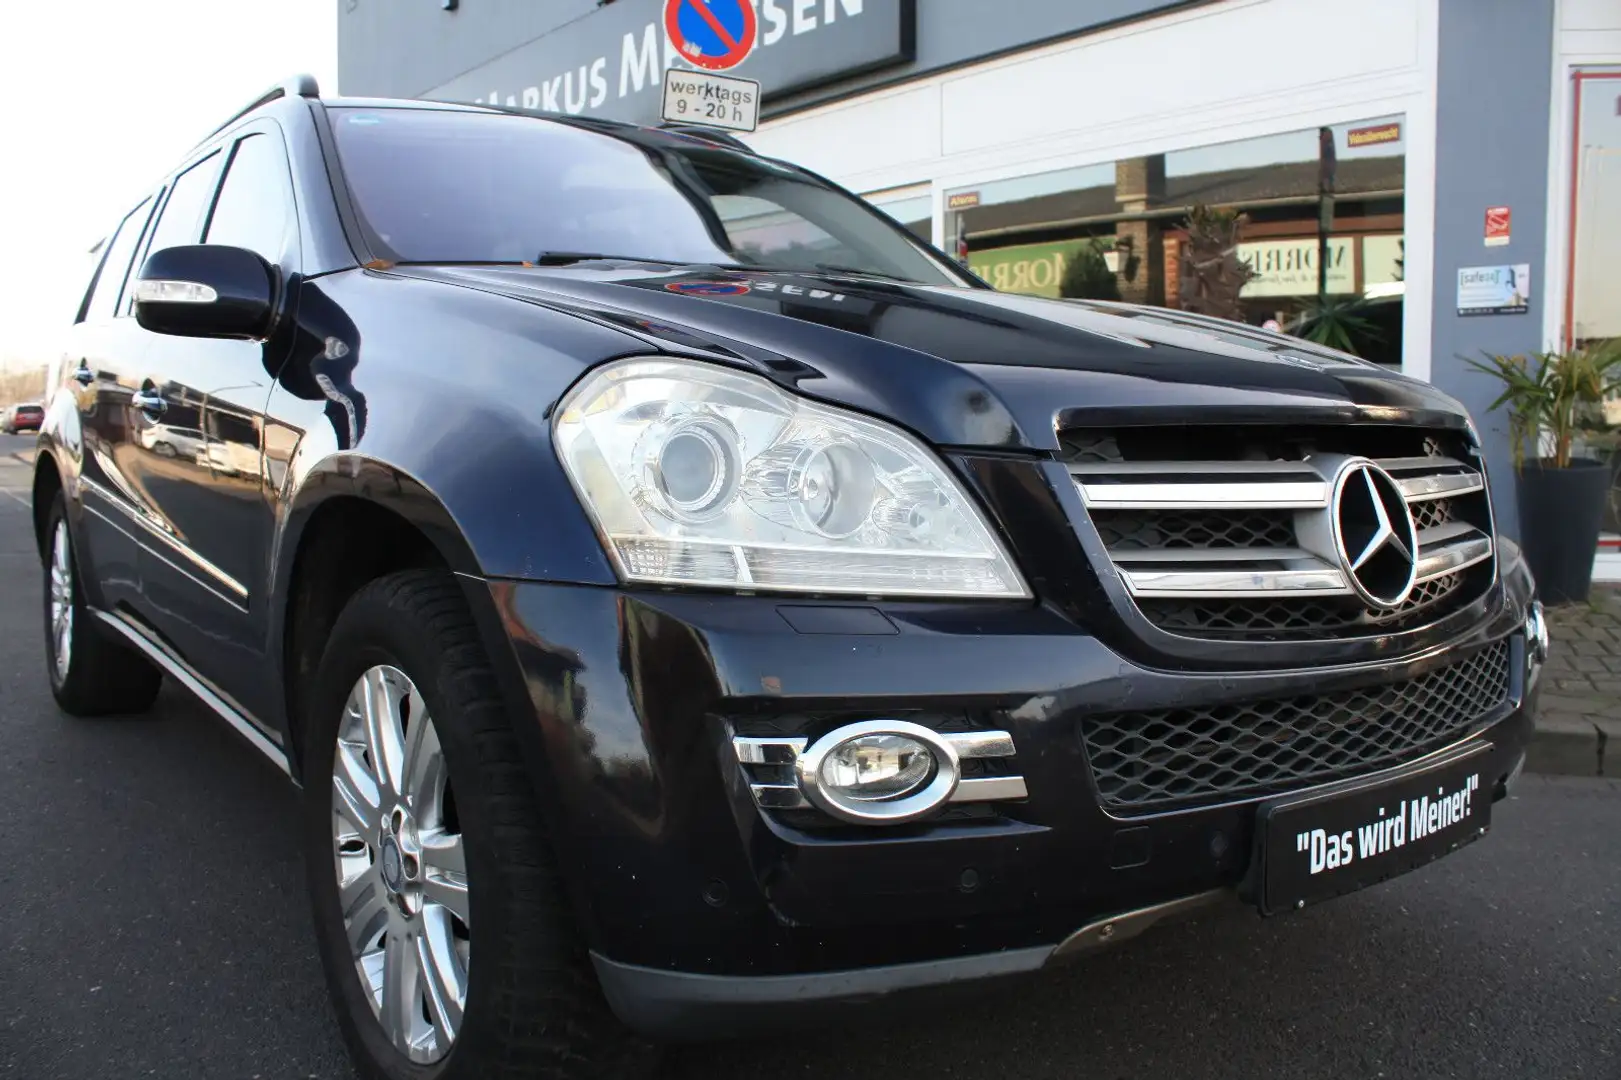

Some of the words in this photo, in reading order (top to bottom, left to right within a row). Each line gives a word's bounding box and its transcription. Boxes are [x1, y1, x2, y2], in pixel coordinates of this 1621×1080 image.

[671, 81, 752, 106] werktags
[677, 99, 687, 114] 9
[706, 102, 726, 119] 20
[732, 106, 742, 122] h
[1297, 828, 1354, 875] "Das
[1358, 801, 1406, 859] wird
[1410, 773, 1479, 842] Meiner!"
